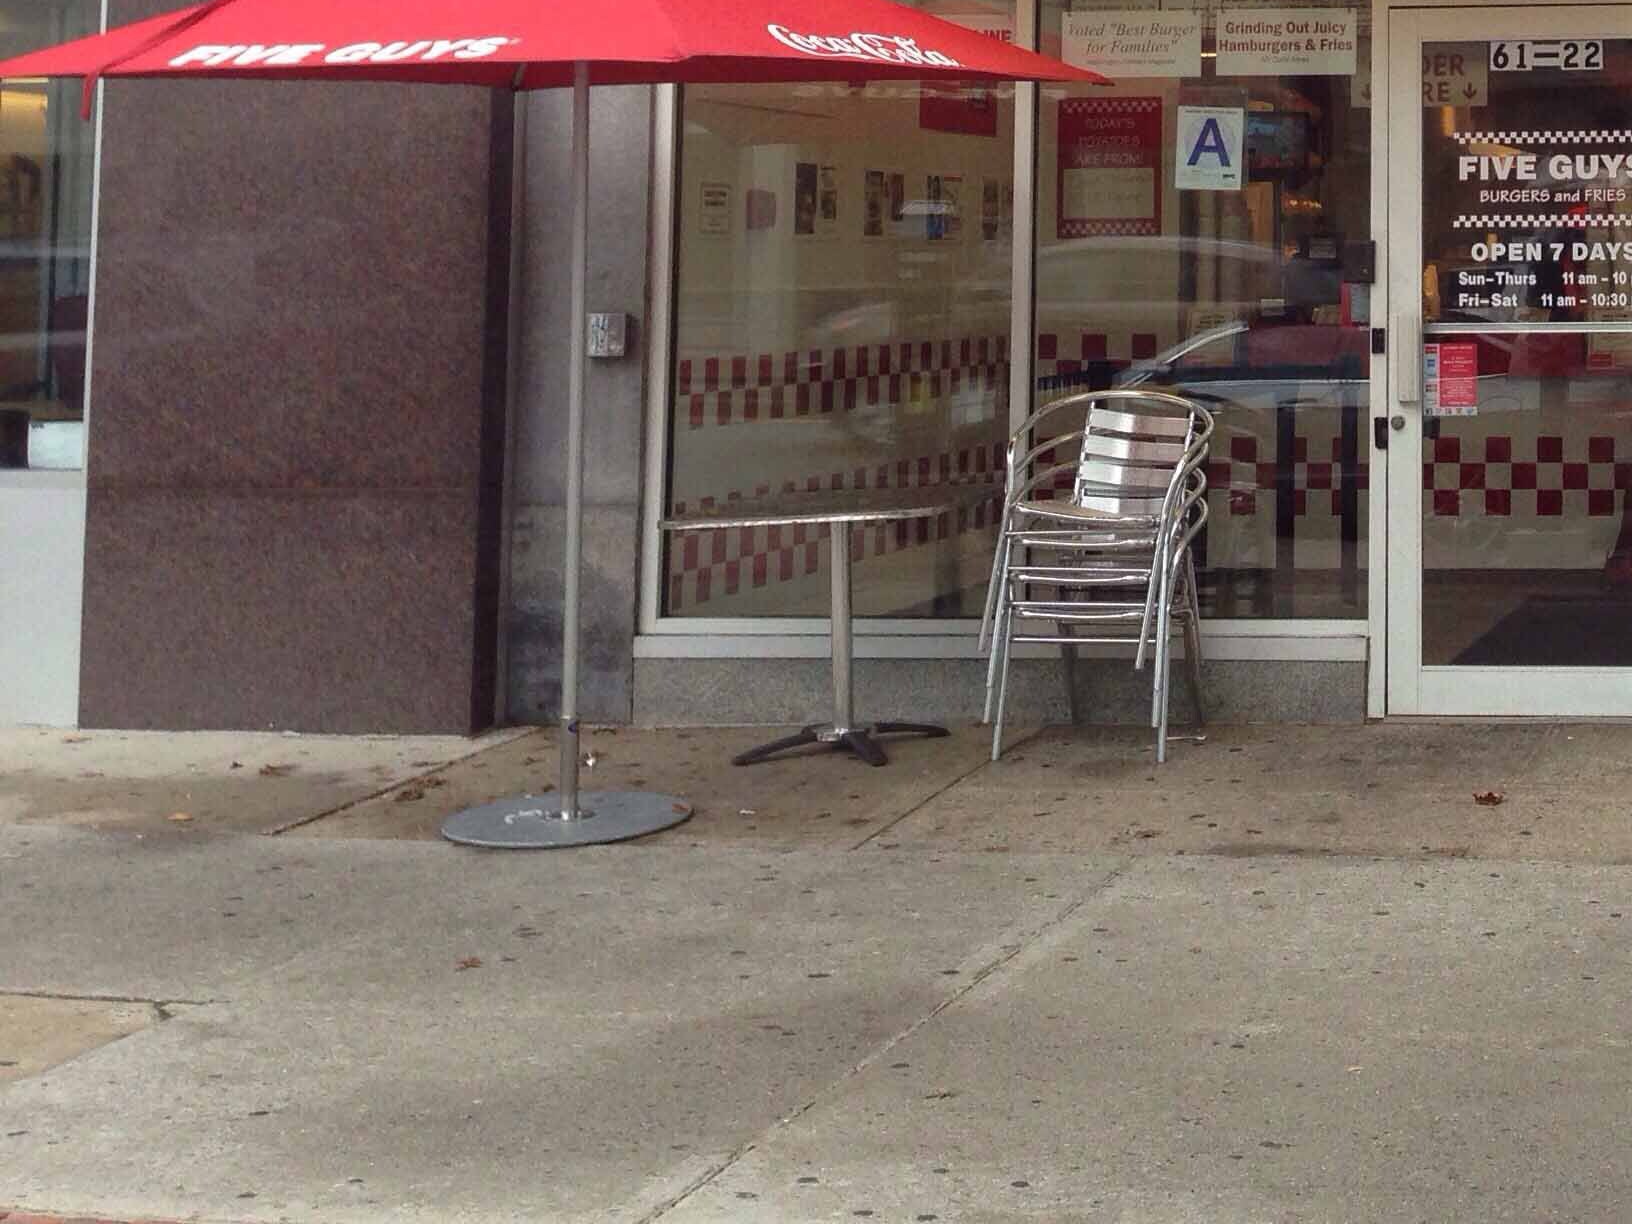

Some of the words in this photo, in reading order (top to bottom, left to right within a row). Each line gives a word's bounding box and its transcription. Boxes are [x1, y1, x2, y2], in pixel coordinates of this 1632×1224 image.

[1068, 24, 1106, 37] Voted
[1150, 23, 1195, 40] Burger
[1225, 21, 1283, 37] Grinding
[1285, 21, 1310, 35] Out
[1312, 21, 1347, 36] Juicy
[168, 43, 326, 67] FIVE
[323, 36, 510, 64] GUYS
[1086, 41, 1105, 55] for
[1218, 39, 1301, 54] Hamburgers
[1304, 38, 1316, 51] &
[1319, 38, 1353, 51] Fries
[1492, 42, 1601, 69] 61-22
[1186, 117, 1231, 167] A
[1458, 156, 1537, 181] FIVE
[1480, 189, 1550, 203] BURGERS
[1554, 189, 1580, 202] and
[1584, 188, 1626, 202] FRIES
[1471, 243, 1542, 262] OPEN
[1550, 243, 1564, 261] 7
[1562, 272, 1575, 285] 11
[1577, 274, 1597, 286] am
[1612, 272, 1627, 285] 10
[1541, 294, 1554, 306] 11
[1556, 295, 1576, 307] am
[1592, 293, 1628, 307] 10:30
